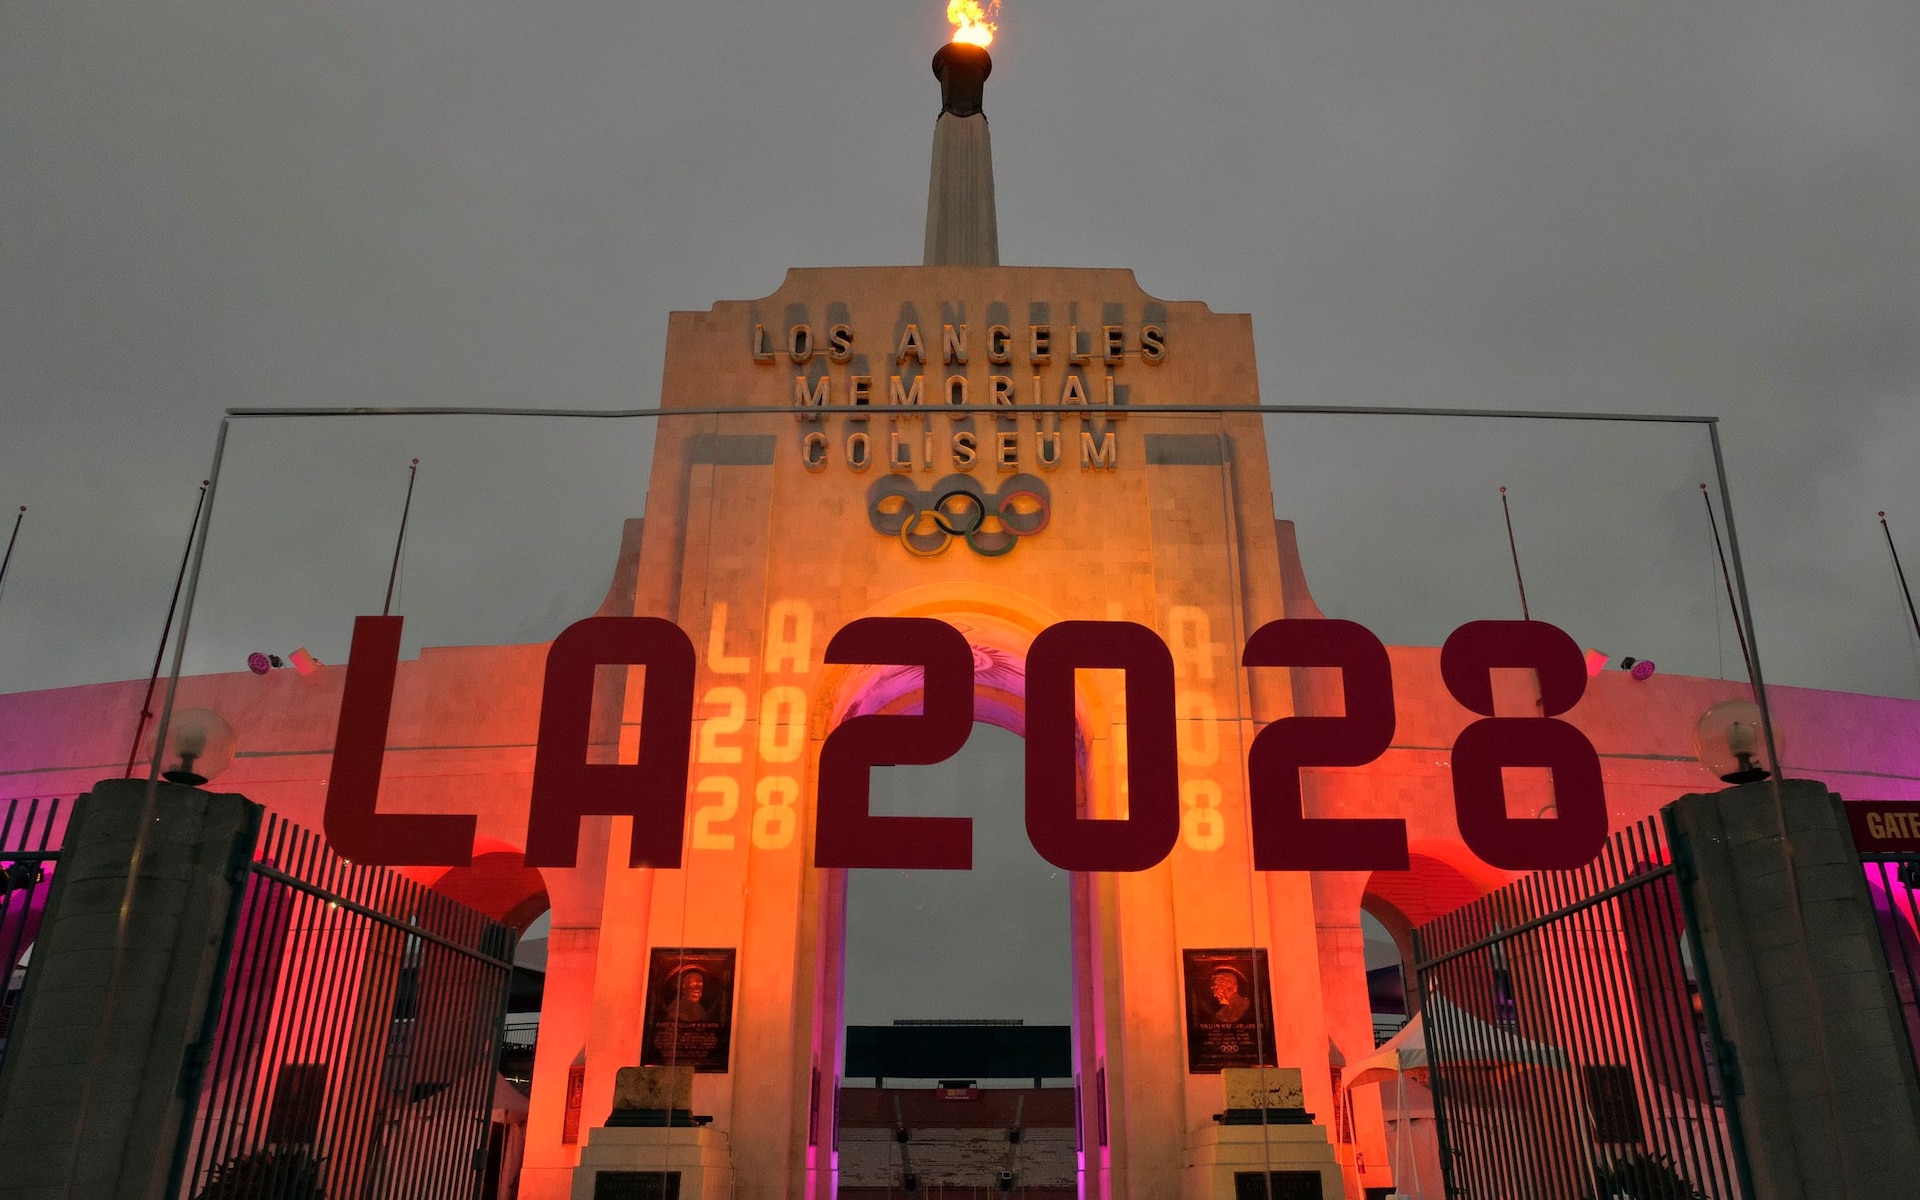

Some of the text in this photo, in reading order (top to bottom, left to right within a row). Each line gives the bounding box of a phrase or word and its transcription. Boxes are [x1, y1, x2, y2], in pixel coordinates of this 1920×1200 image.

[752, 323, 1167, 367] LOS ANGELES
[794, 375, 1127, 421] MEMORIAL
[802, 431, 1118, 473] COLISEUM
[707, 600, 814, 674] LA
[698, 686, 808, 764] 20
[692, 775, 800, 850] 28
[1866, 812, 1920, 839] GATE
